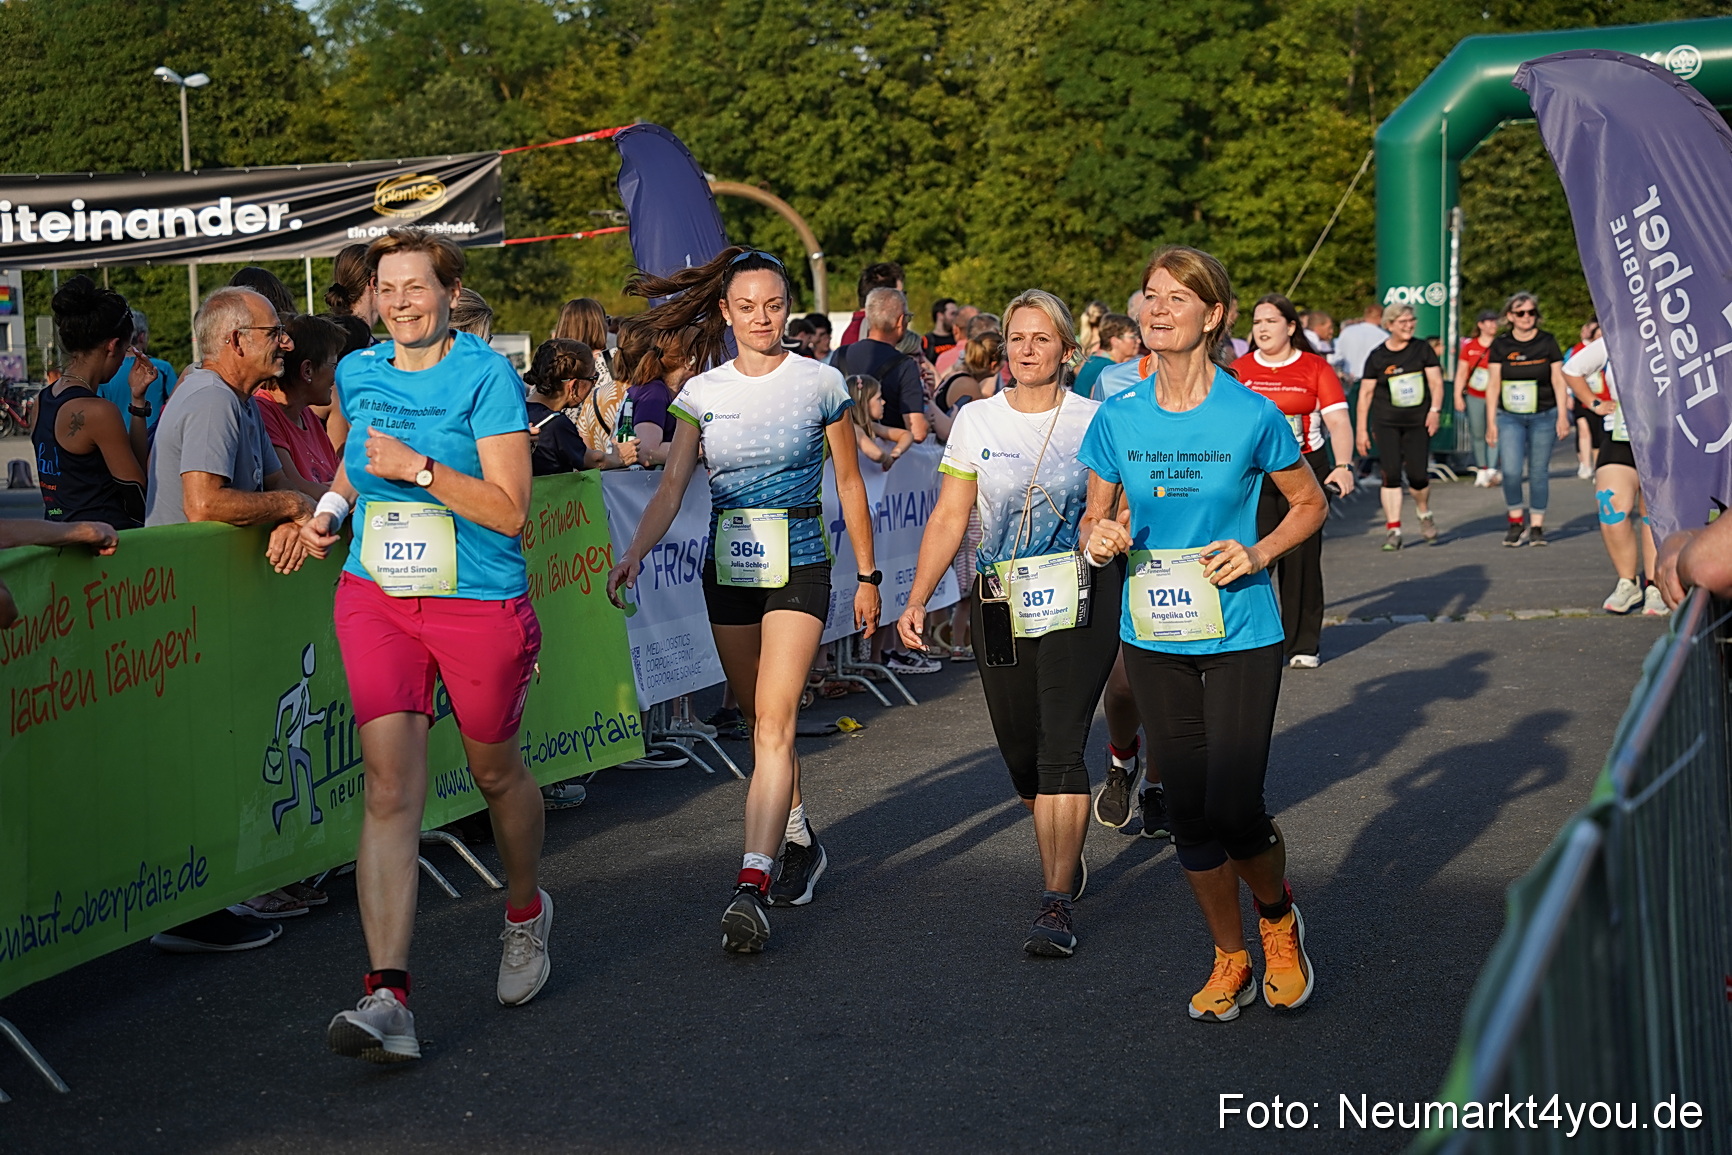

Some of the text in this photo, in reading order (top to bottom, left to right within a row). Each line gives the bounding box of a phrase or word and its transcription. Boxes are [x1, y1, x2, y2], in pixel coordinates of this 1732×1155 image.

[347, 226, 366, 239] Ein
[1383, 286, 1426, 305] AOK
[360, 399, 447, 416] Wir halten Immobilien
[371, 417, 417, 430] am Laufen.
[1128, 450, 1232, 462] Wir halten Immobilien
[1150, 467, 1203, 479] am Laufen.
[539, 500, 591, 545] Firmen
[384, 542, 427, 560] 1217
[731, 541, 765, 557] 364
[377, 565, 409, 574] Irmgard
[547, 543, 614, 596] länger
[745, 561, 769, 569] Schlegl
[84, 566, 177, 630] Firmen
[1023, 588, 1055, 607] 387
[1147, 588, 1192, 606] 1214
[1151, 612, 1183, 620] Angelika
[646, 647, 695, 673] CORPORATE PRINT
[10, 605, 202, 737] laufen länger!
[646, 668, 680, 688] CORPORATE
